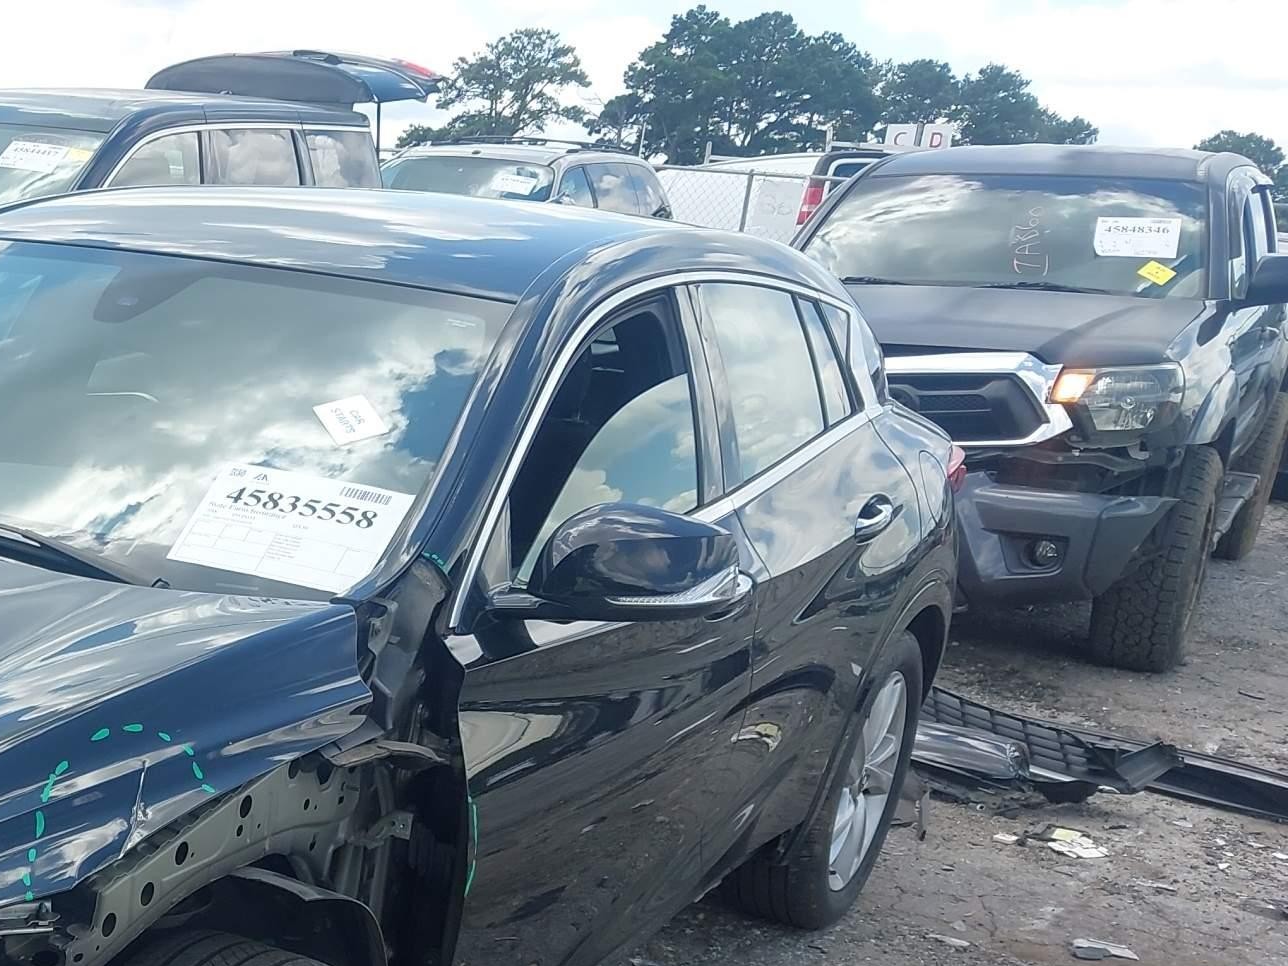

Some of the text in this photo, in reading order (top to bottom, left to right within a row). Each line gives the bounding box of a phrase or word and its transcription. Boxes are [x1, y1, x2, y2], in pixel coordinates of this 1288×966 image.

[893, 131, 908, 147] C
[929, 132, 943, 148] D
[1104, 225, 1170, 234] 45848346
[225, 486, 378, 530] 45835558
